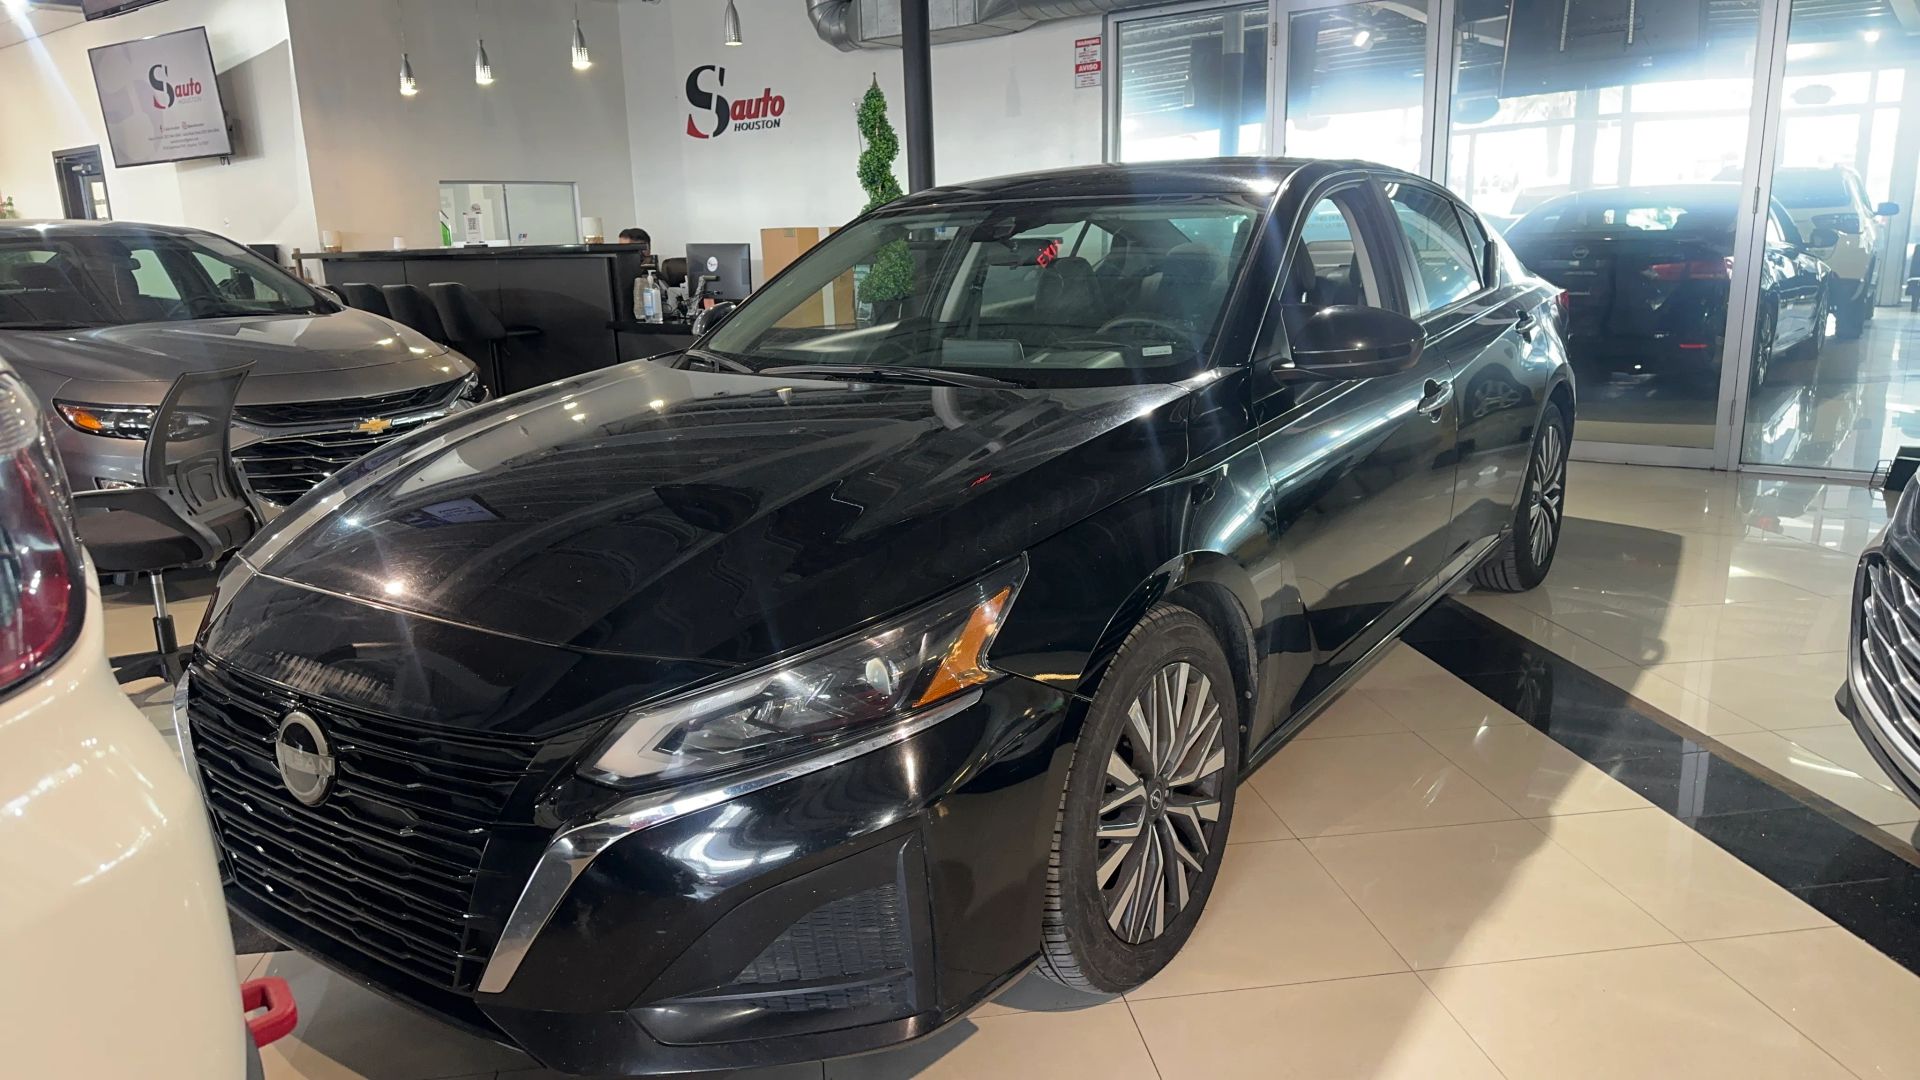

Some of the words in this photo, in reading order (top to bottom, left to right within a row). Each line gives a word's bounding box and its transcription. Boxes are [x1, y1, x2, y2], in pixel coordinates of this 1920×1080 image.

[1078, 63, 1098, 72] AVISO
[149, 64, 175, 109] S
[175, 77, 202, 98] auto
[685, 64, 730, 139] S
[730, 88, 785, 121] auto
[733, 119, 781, 132] HOUSTON
